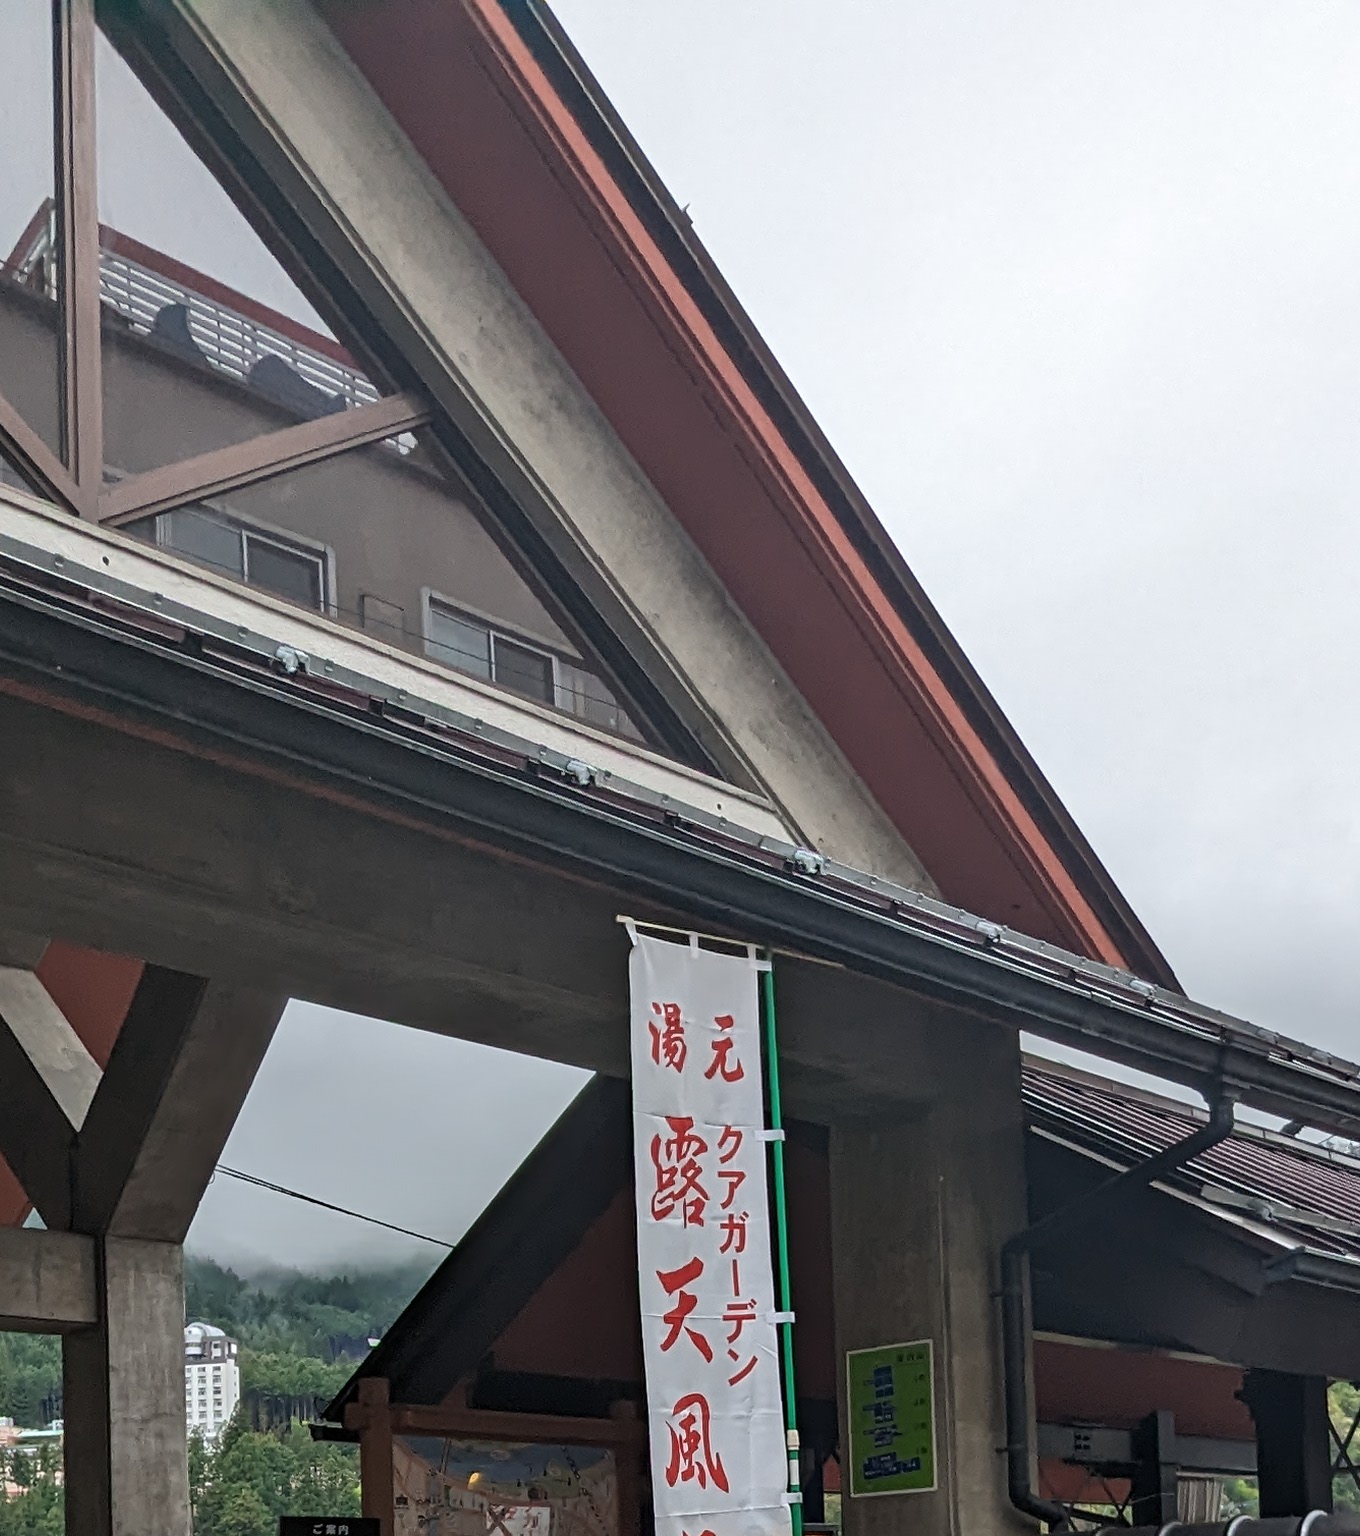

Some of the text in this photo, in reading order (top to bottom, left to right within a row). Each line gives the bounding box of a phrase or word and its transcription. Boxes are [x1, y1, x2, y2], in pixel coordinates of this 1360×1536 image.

[714, 1124, 758, 1388] クアガーデン
[312, 1523, 349, 1536] ご案内
